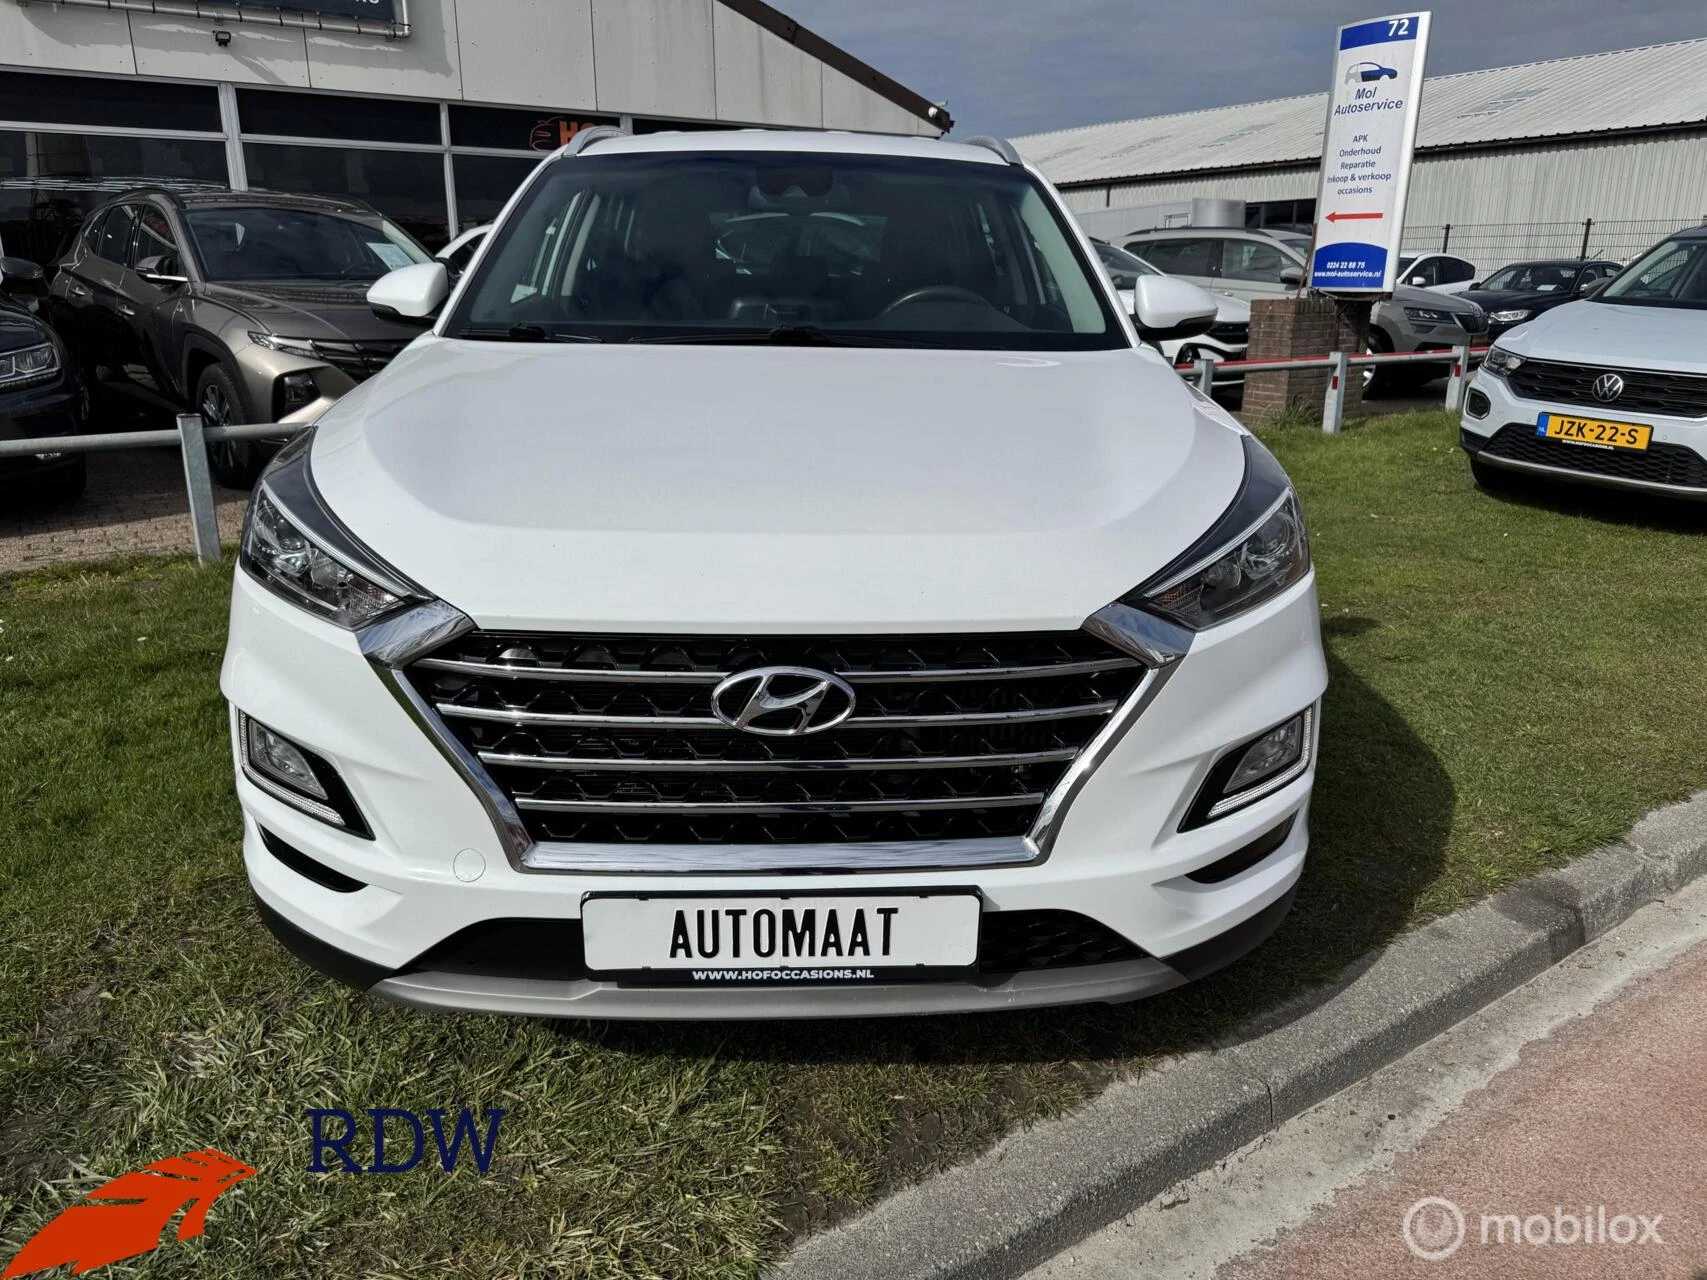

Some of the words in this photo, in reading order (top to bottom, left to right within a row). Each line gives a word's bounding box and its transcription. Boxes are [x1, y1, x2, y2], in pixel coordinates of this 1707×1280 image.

[1388, 18, 1409, 37] 72
[1355, 86, 1377, 100] Mol
[1334, 98, 1403, 116] Autoservice
[1353, 134, 1368, 143] APK
[1339, 146, 1382, 157] Onderhoud
[1340, 159, 1376, 170] Reparatie
[1327, 175, 1349, 184] Inkoop
[1350, 173, 1356, 182] &
[1358, 172, 1392, 182] verkoop
[1337, 185, 1373, 195] occasions
[1554, 419, 1639, 445] JZK-22-S
[669, 907, 899, 958] AUTOMAAT
[692, 969, 875, 981] WWW.HOFOCCASIONS.NL
